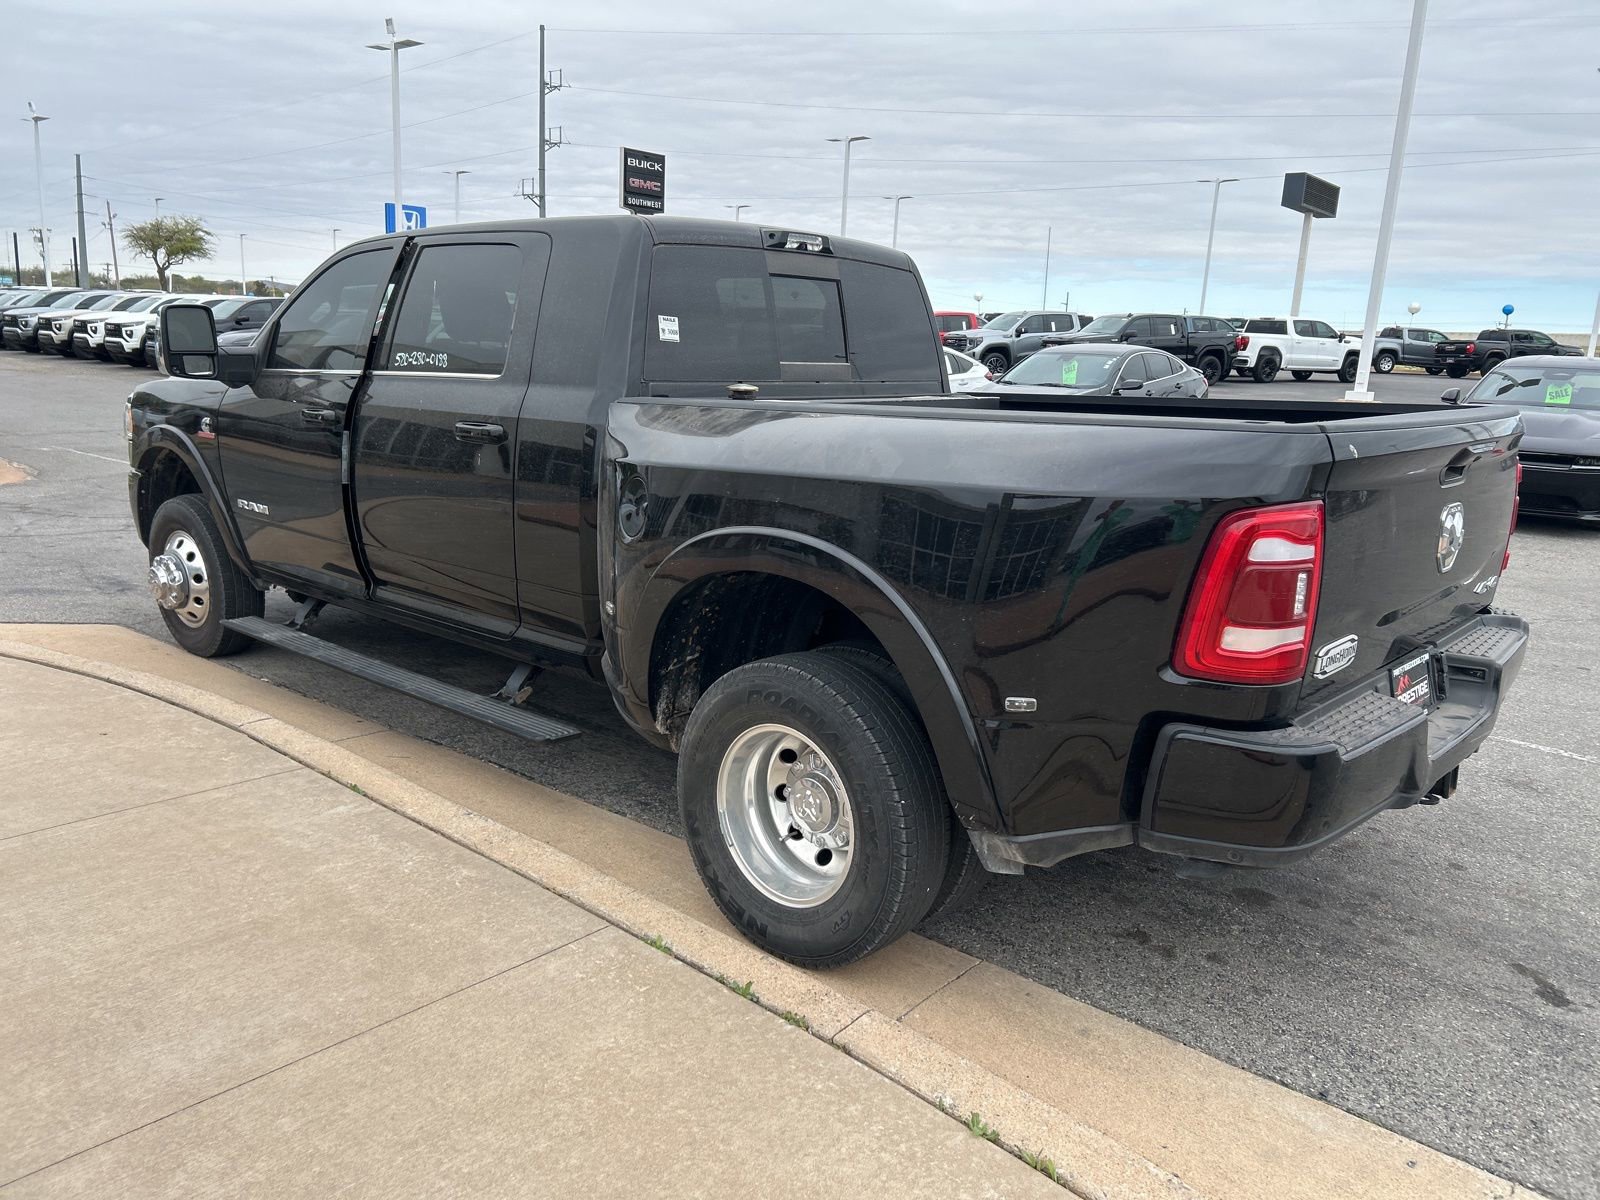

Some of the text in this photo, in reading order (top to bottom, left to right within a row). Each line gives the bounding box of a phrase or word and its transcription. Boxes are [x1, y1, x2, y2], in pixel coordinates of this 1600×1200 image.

[627, 157, 663, 172] BUICK
[628, 177, 661, 191] GMC
[627, 197, 662, 209] SOUTHWEST
[1548, 388, 1571, 401] SALE
[237, 498, 270, 515] RAM
